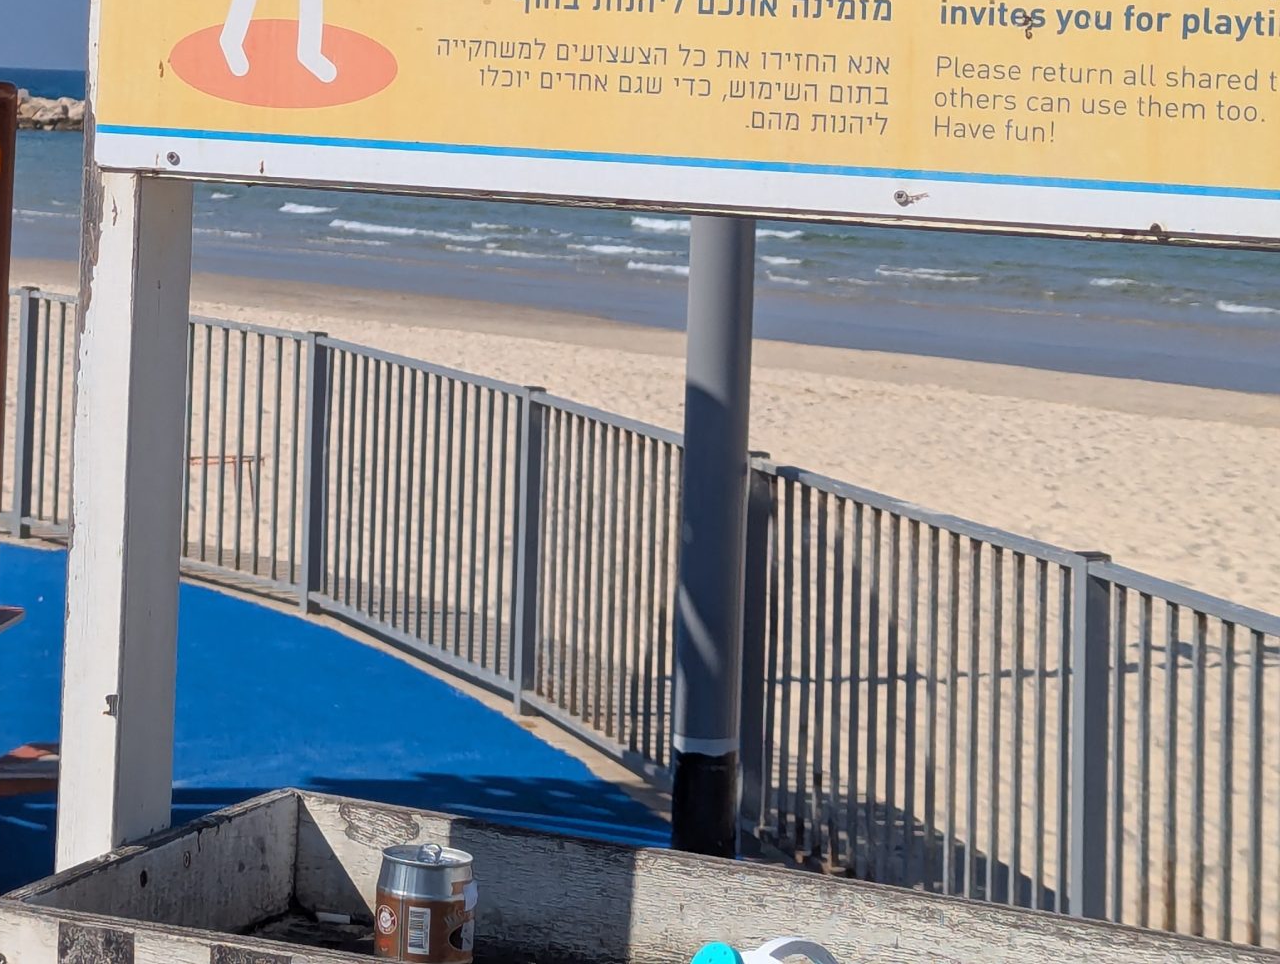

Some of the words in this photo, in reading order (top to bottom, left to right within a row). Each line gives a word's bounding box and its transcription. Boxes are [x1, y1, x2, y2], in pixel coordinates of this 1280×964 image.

[940, 0, 1046, 28] invites
[1056, 9, 1112, 35] you
[1123, 4, 1172, 33] for
[1181, 6, 1280, 43] playti
[437, 38, 547, 62] למשחקייה
[556, 42, 668, 67] הצעצועים
[677, 43, 706, 68] כל
[715, 48, 750, 70] את
[760, 50, 838, 74] החזירו
[478, 65, 531, 88] יוכלו
[847, 54, 891, 76] אנא
[936, 55, 1021, 81] Please
[1031, 63, 1113, 85] return
[1123, 63, 1157, 87] all
[1166, 65, 1258, 92] shared
[539, 70, 609, 93] אחרים
[618, 74, 663, 96] שגם
[673, 76, 712, 98] כדי
[721, 79, 819, 103] השימוש,
[829, 83, 890, 106] בתום
[934, 87, 1017, 111] others
[1026, 95, 1071, 114] can
[1081, 97, 1128, 117] use
[1136, 96, 1206, 121] them
[1216, 100, 1266, 123] too.
[744, 110, 801, 132] מהם.
[810, 111, 890, 136] ליהנות
[933, 116, 996, 140] Have
[1005, 119, 1055, 143] fun!
